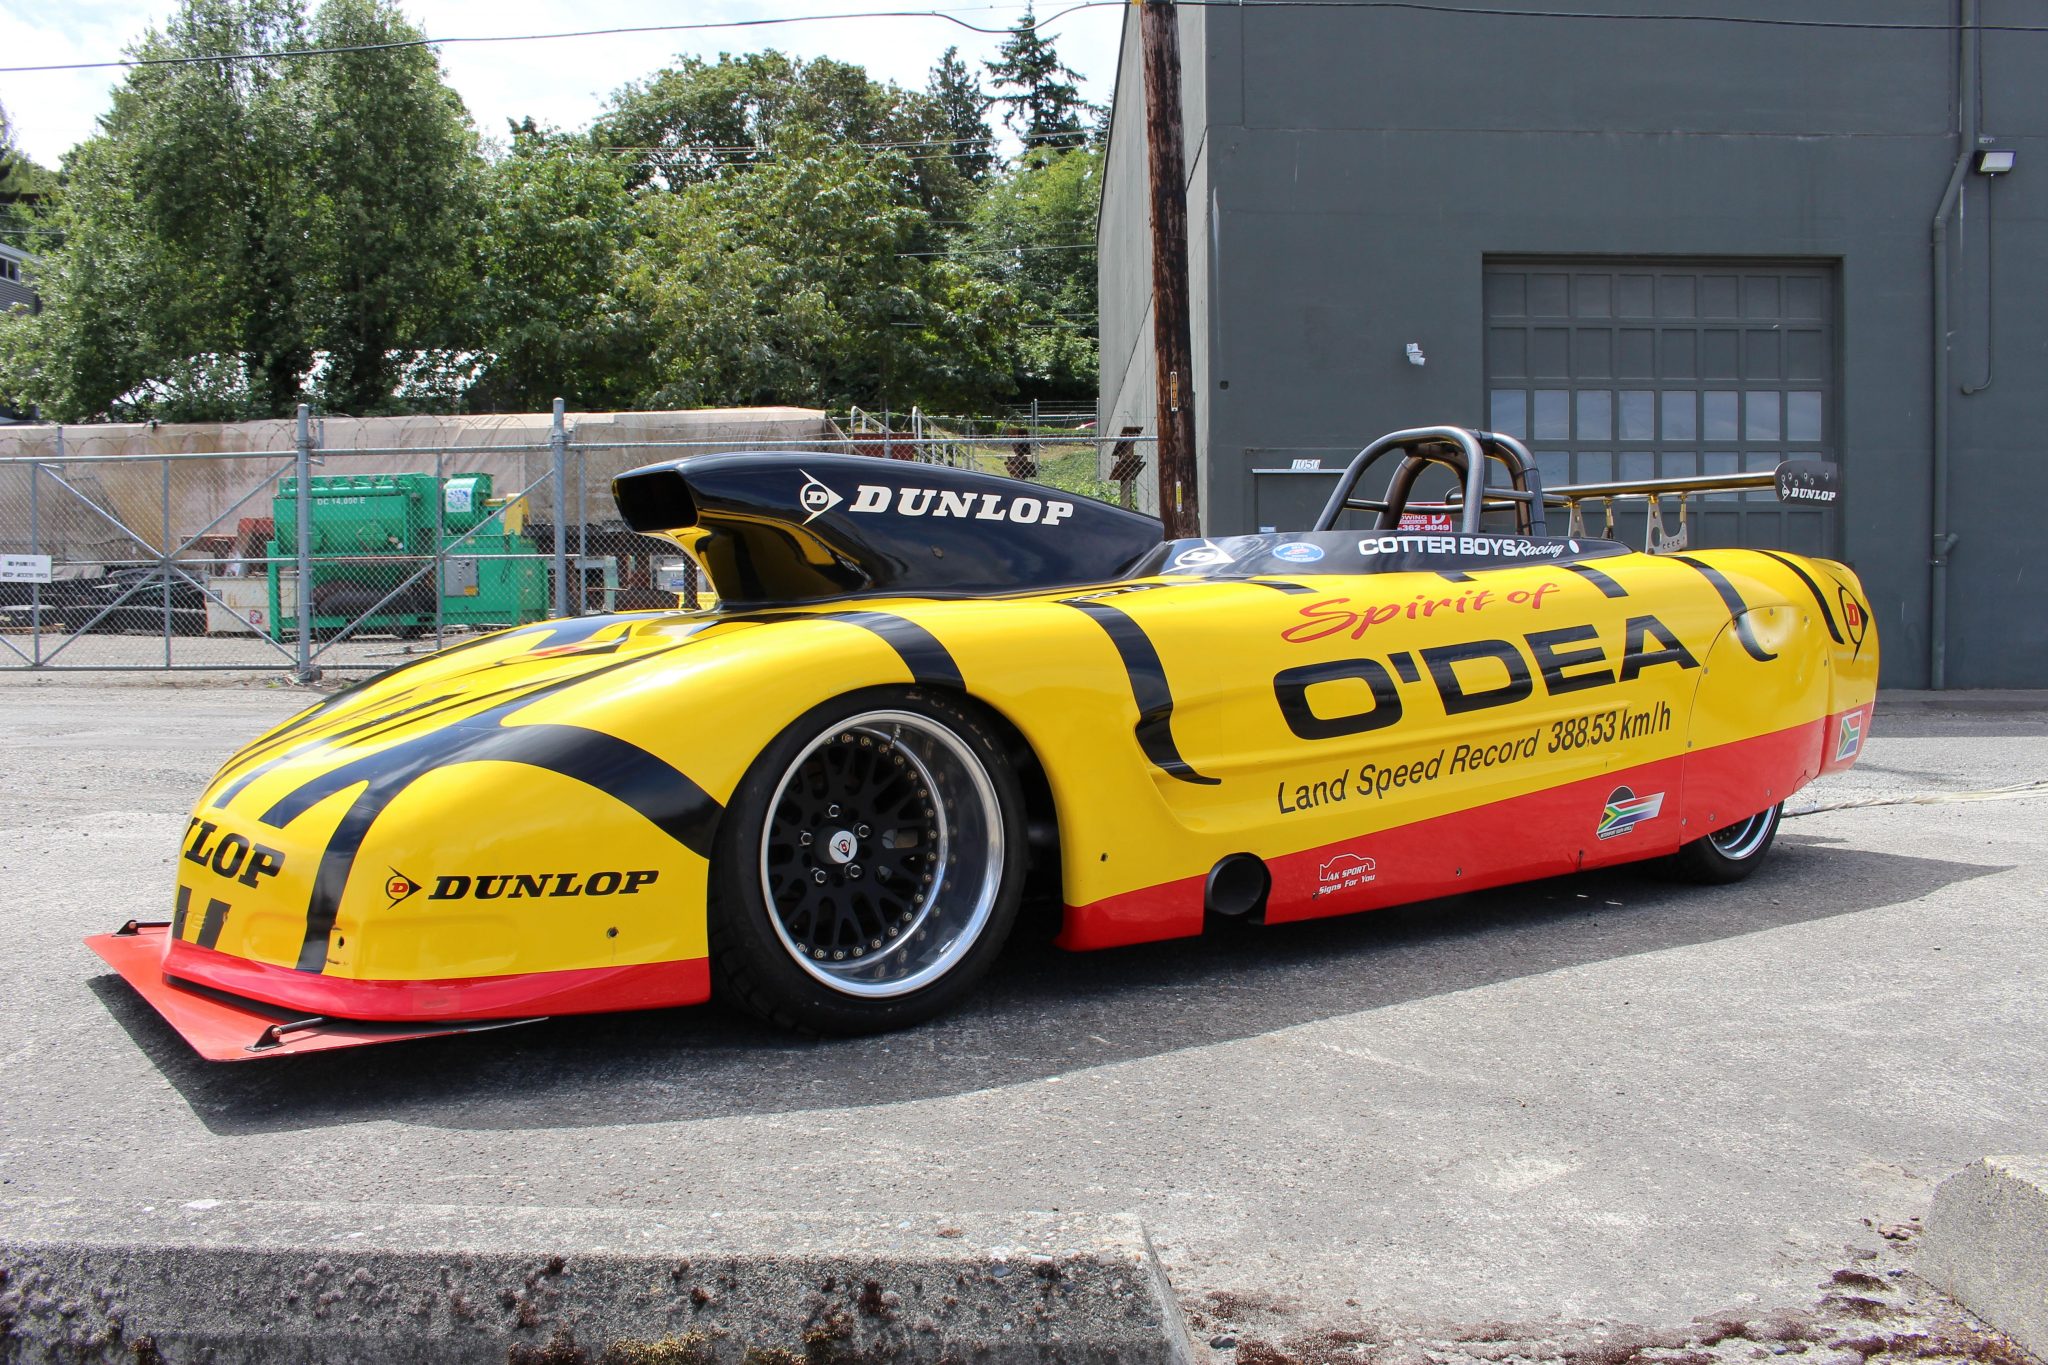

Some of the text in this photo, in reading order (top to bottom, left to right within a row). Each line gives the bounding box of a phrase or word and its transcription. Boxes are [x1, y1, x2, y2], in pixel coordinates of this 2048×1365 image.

[848, 485, 1074, 526] DUNLOP
[1791, 487, 1836, 501] DUNLOP
[1358, 536, 1565, 558] COTTER BOYS Racing
[1281, 583, 1561, 643] Spirit of
[1273, 614, 1701, 741] O'DEA
[1276, 768, 1351, 814] Land
[1356, 749, 1445, 799] Speed
[1449, 729, 1541, 775] Record
[1619, 700, 1672, 741] km/h
[427, 870, 660, 900] DUNLOP
[1319, 875, 1375, 894] Signs For You
[1342, 864, 1367, 878] SPORT
